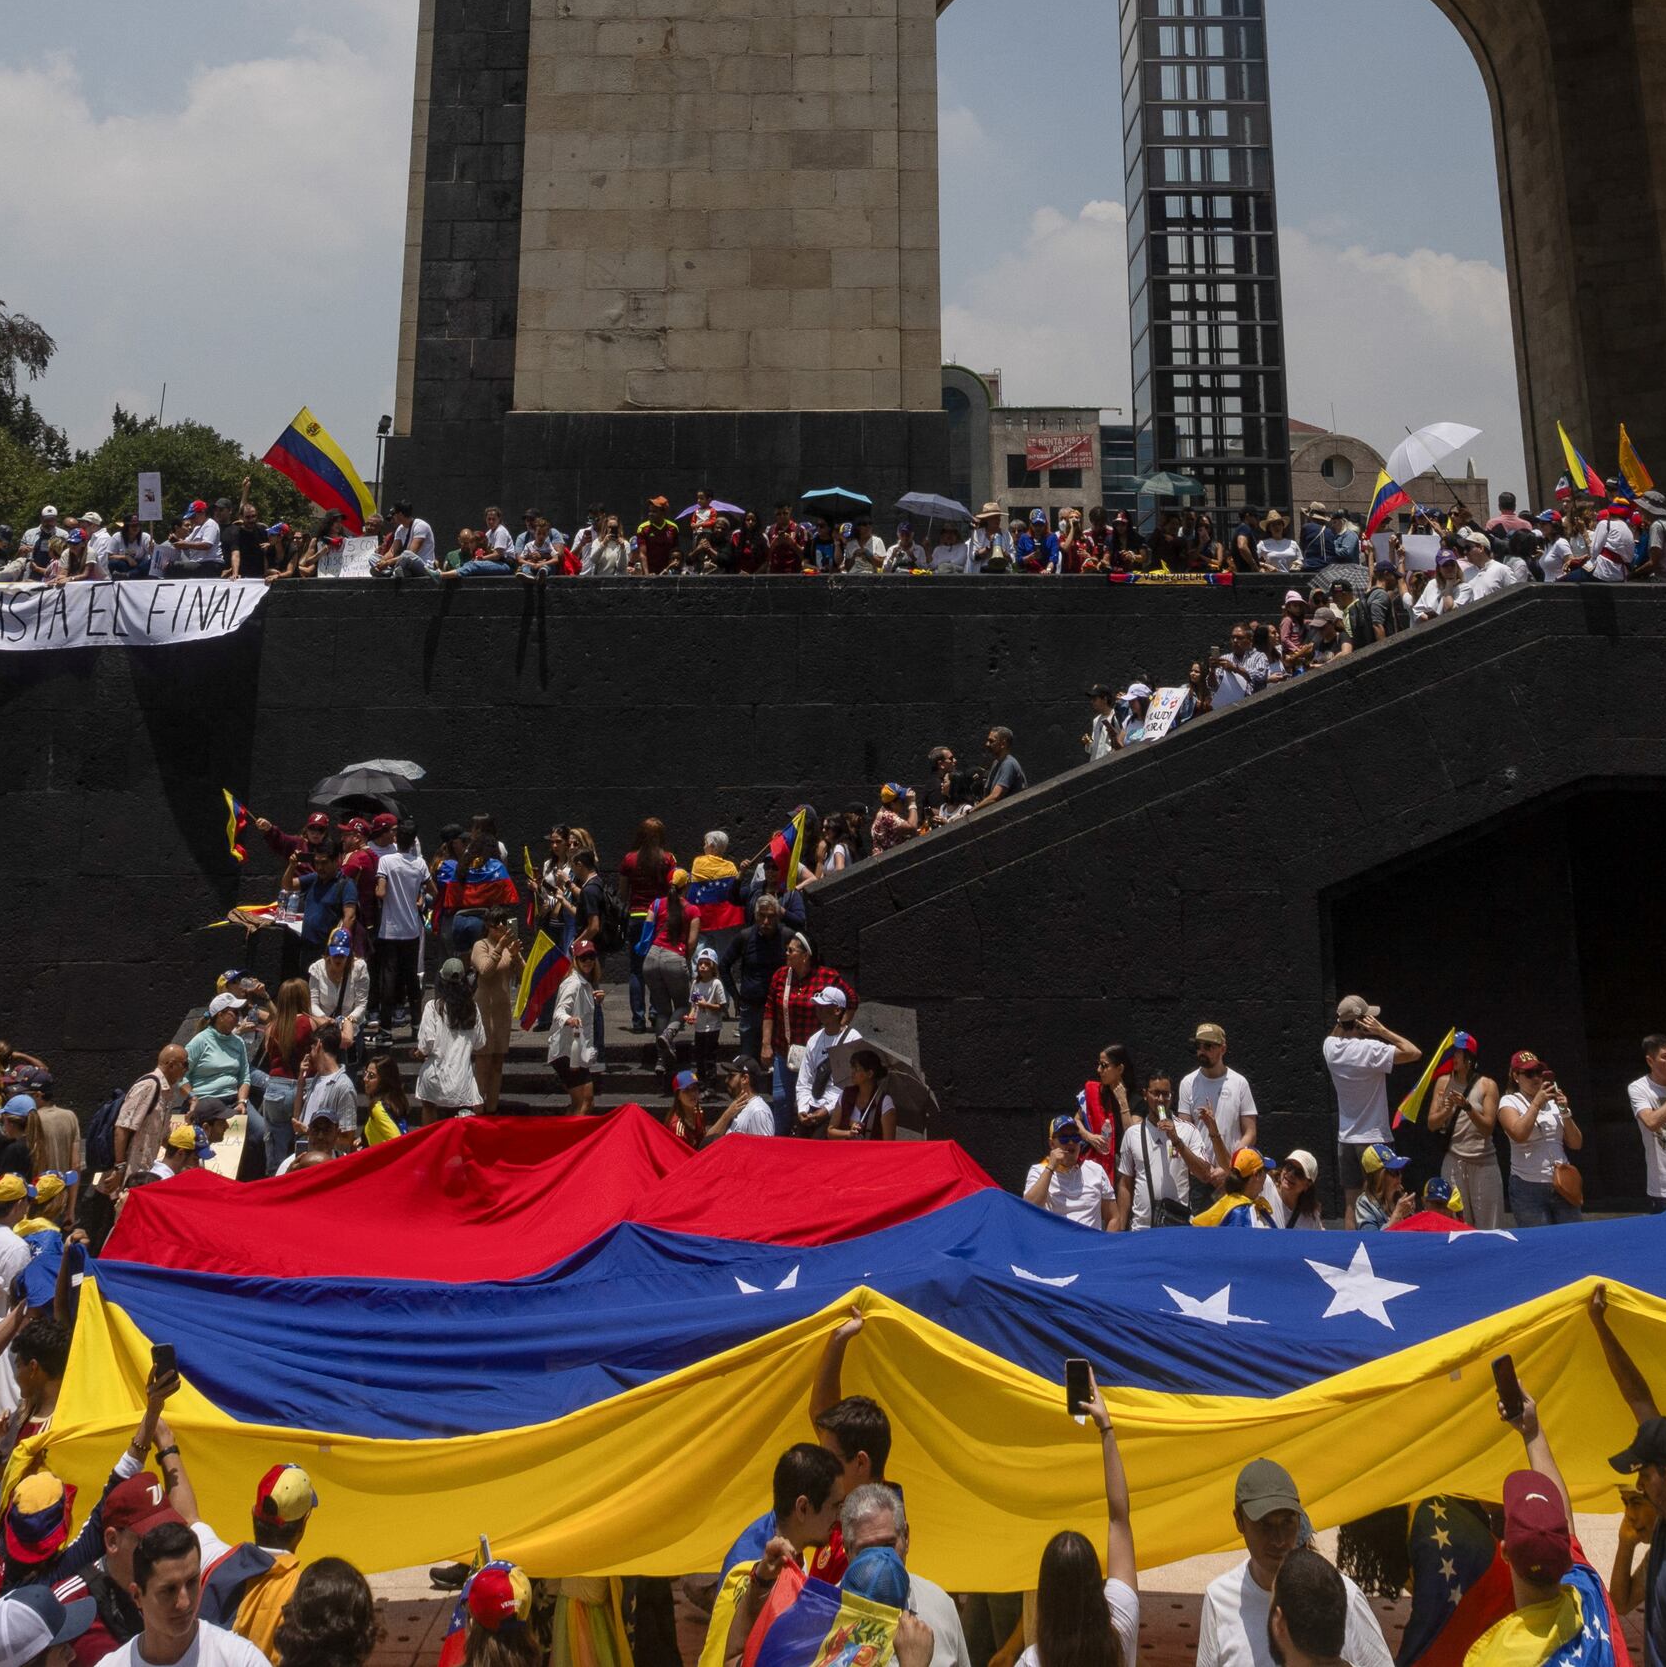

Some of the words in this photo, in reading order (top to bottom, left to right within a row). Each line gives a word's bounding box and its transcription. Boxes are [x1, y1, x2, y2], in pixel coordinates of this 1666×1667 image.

[1038, 437, 1063, 447] RENTA
[1064, 435, 1081, 445] PISO
[1045, 445, 1051, 454] Y
[1143, 573, 1203, 581] VENEZUELA
[86, 582, 129, 637] EL
[146, 583, 246, 636] FINAL
